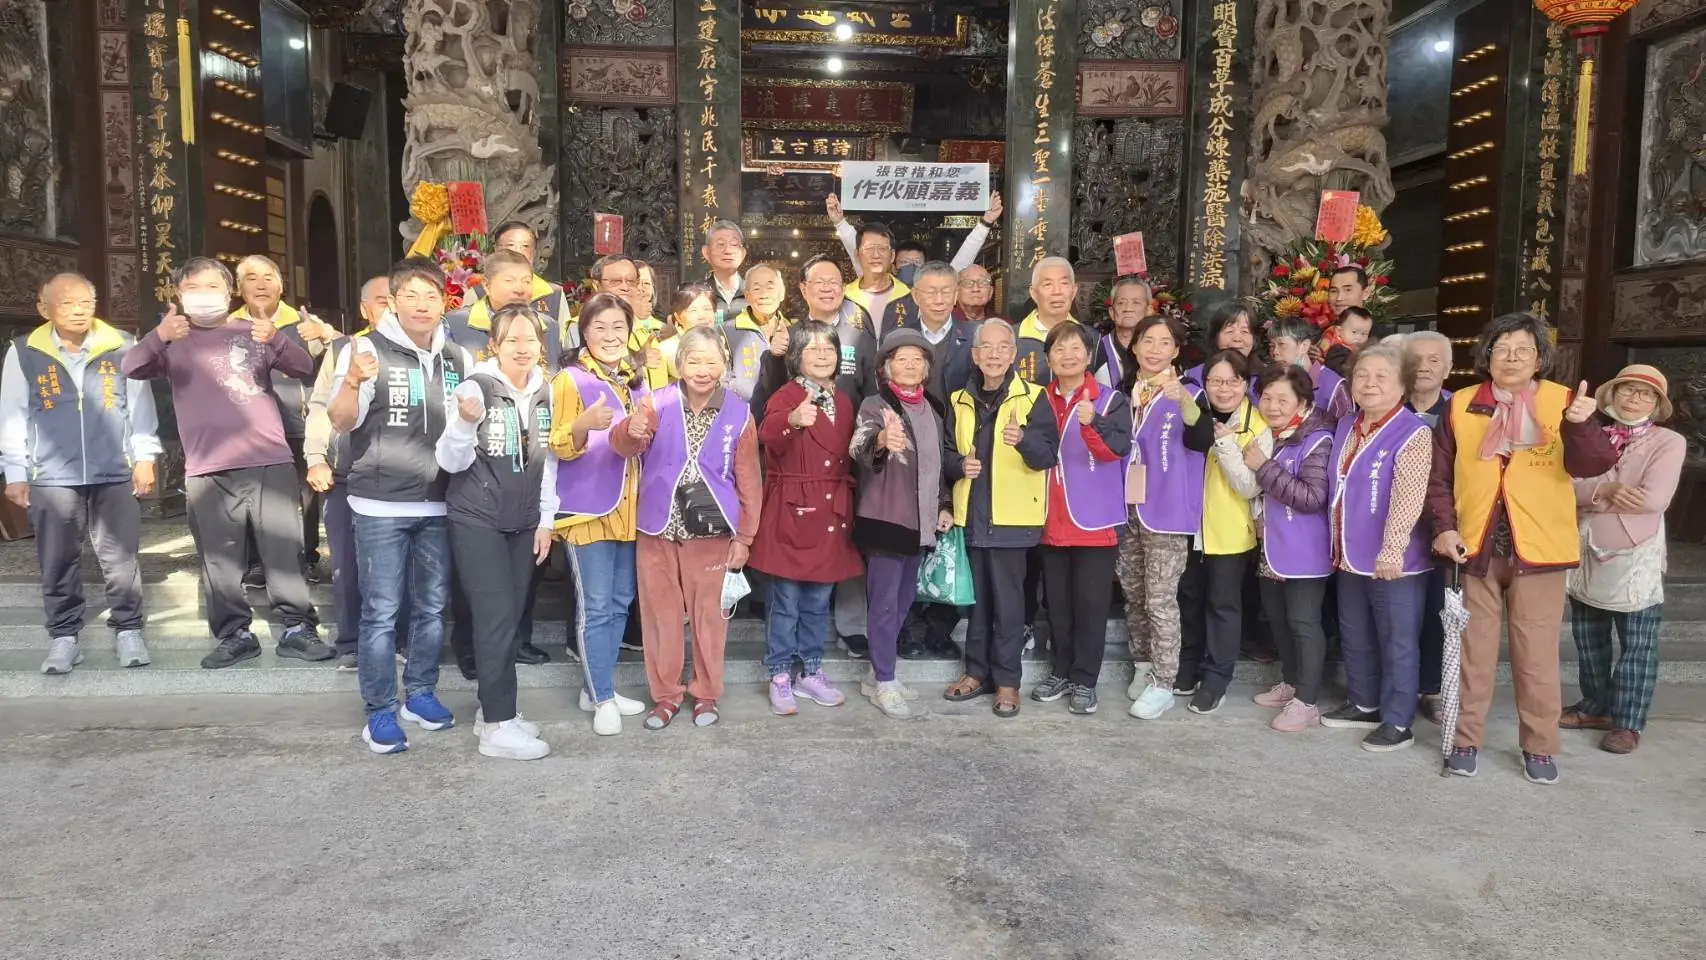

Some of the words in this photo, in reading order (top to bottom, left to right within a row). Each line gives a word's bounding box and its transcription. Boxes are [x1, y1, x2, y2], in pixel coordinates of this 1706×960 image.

[852, 180, 981, 201] 作伙顧嘉義
[387, 366, 409, 427] 王閔正
